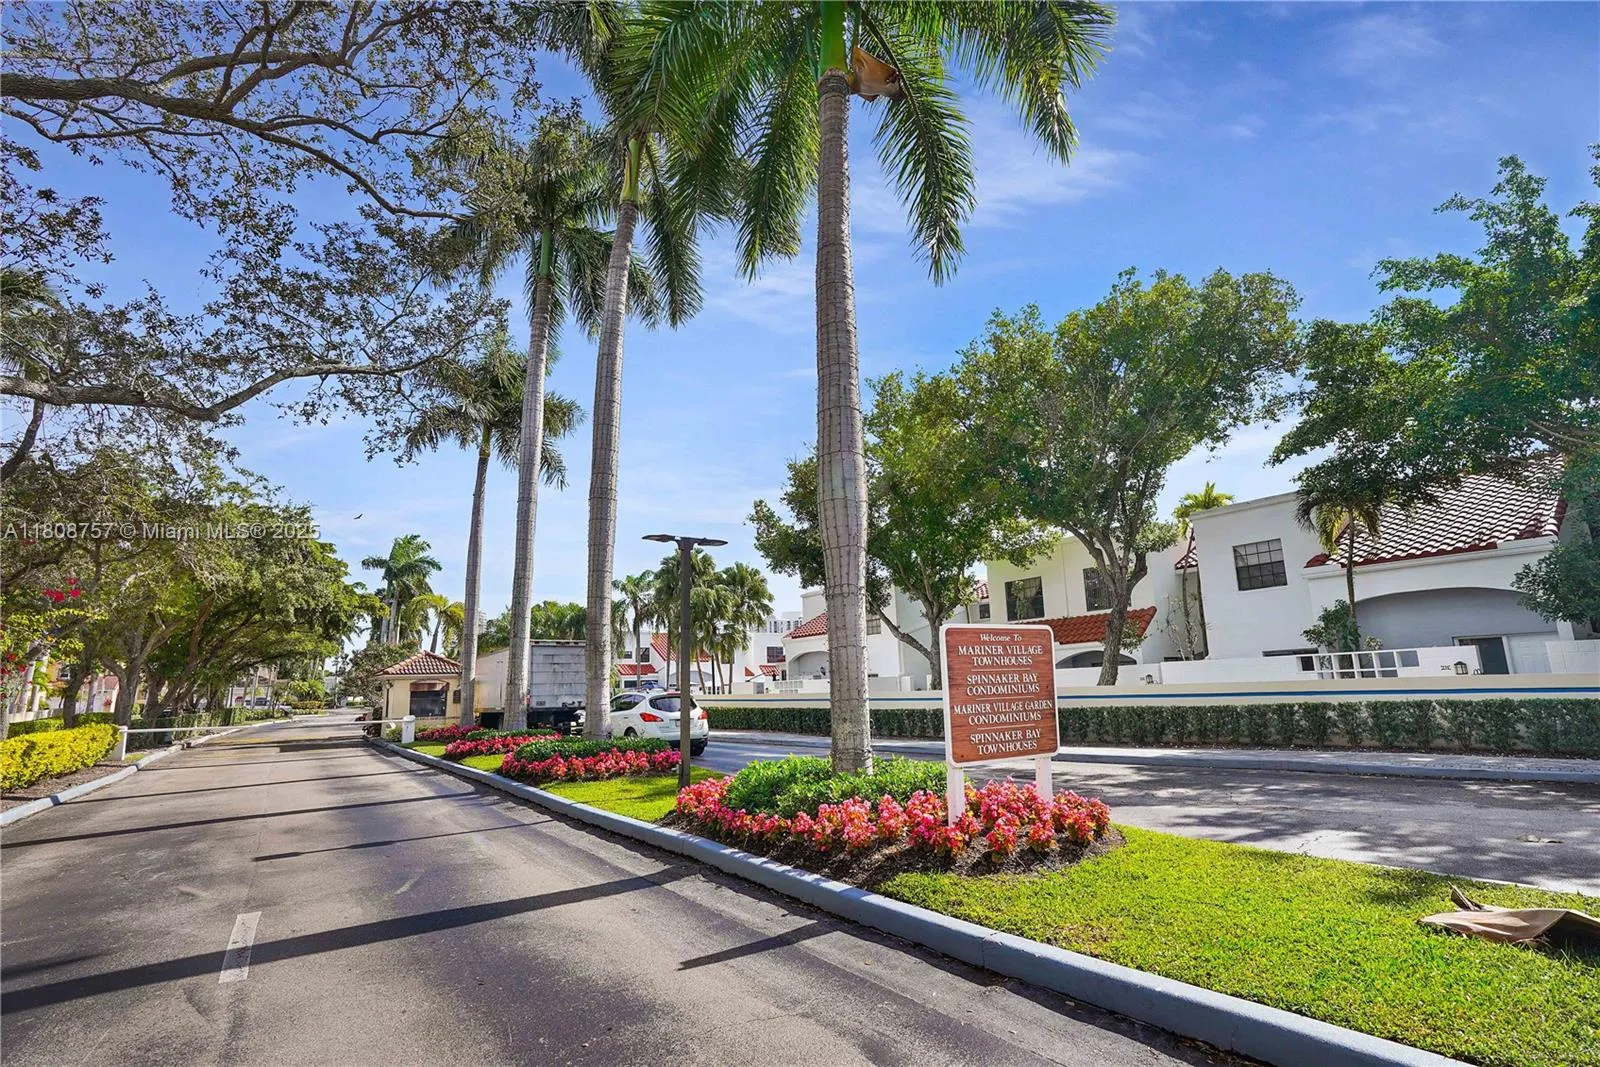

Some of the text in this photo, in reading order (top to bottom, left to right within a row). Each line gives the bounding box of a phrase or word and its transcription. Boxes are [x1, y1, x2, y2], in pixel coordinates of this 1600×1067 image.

[958, 646, 1043, 655] MARINER VILLAGE
[972, 656, 1032, 666] TOWNHOUSES
[967, 673, 1038, 684] SPINNAKER BAY
[967, 684, 1040, 696] CONDOMINIUMS
[954, 700, 1052, 715] MARINER VILLAGE GARDEN
[968, 711, 1042, 726] CONDOMINIUMS
[970, 729, 1041, 744] SPINNAKER BAY
[978, 740, 1037, 754] TOWNHOUSES
